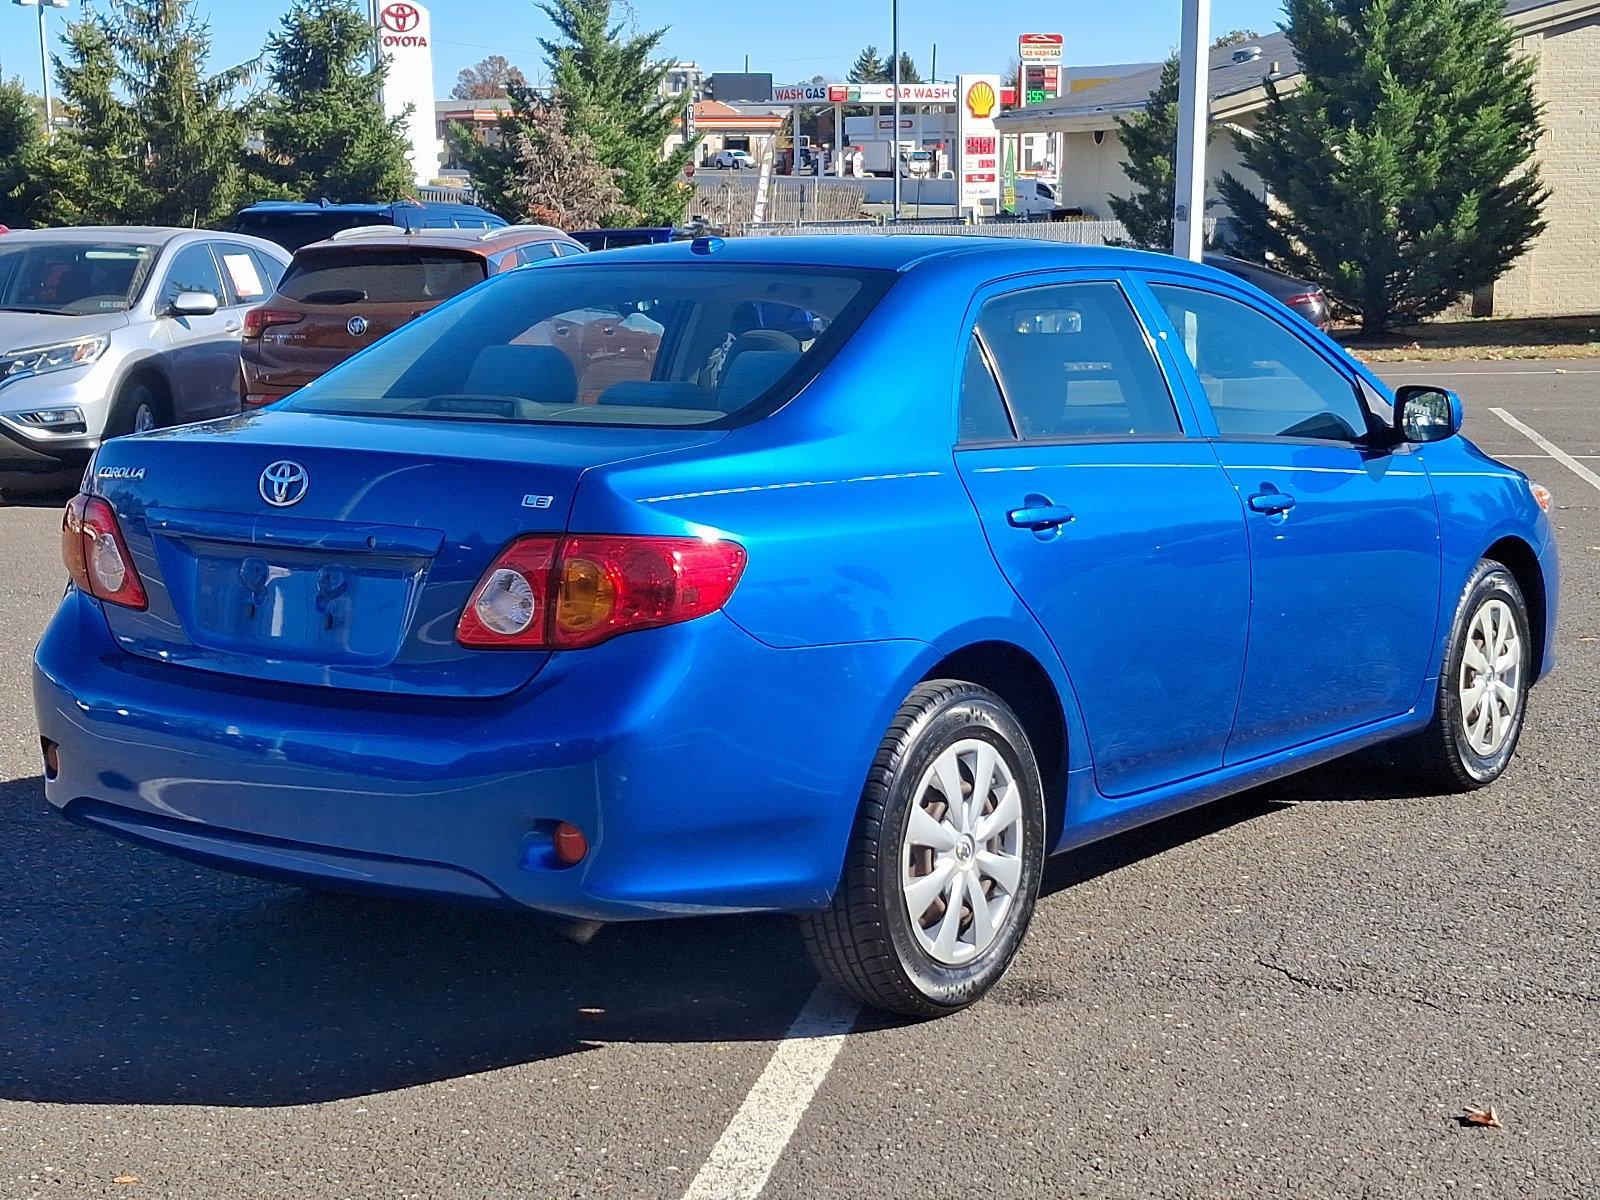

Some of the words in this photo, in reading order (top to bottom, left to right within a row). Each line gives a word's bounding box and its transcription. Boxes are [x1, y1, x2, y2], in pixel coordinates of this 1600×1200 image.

[380, 36, 427, 47] OYOTA
[775, 88, 803, 101] WASH
[806, 87, 826, 100] GAS
[913, 88, 950, 98] WASH
[98, 466, 146, 479] COROLLA
[523, 495, 551, 507] LE
